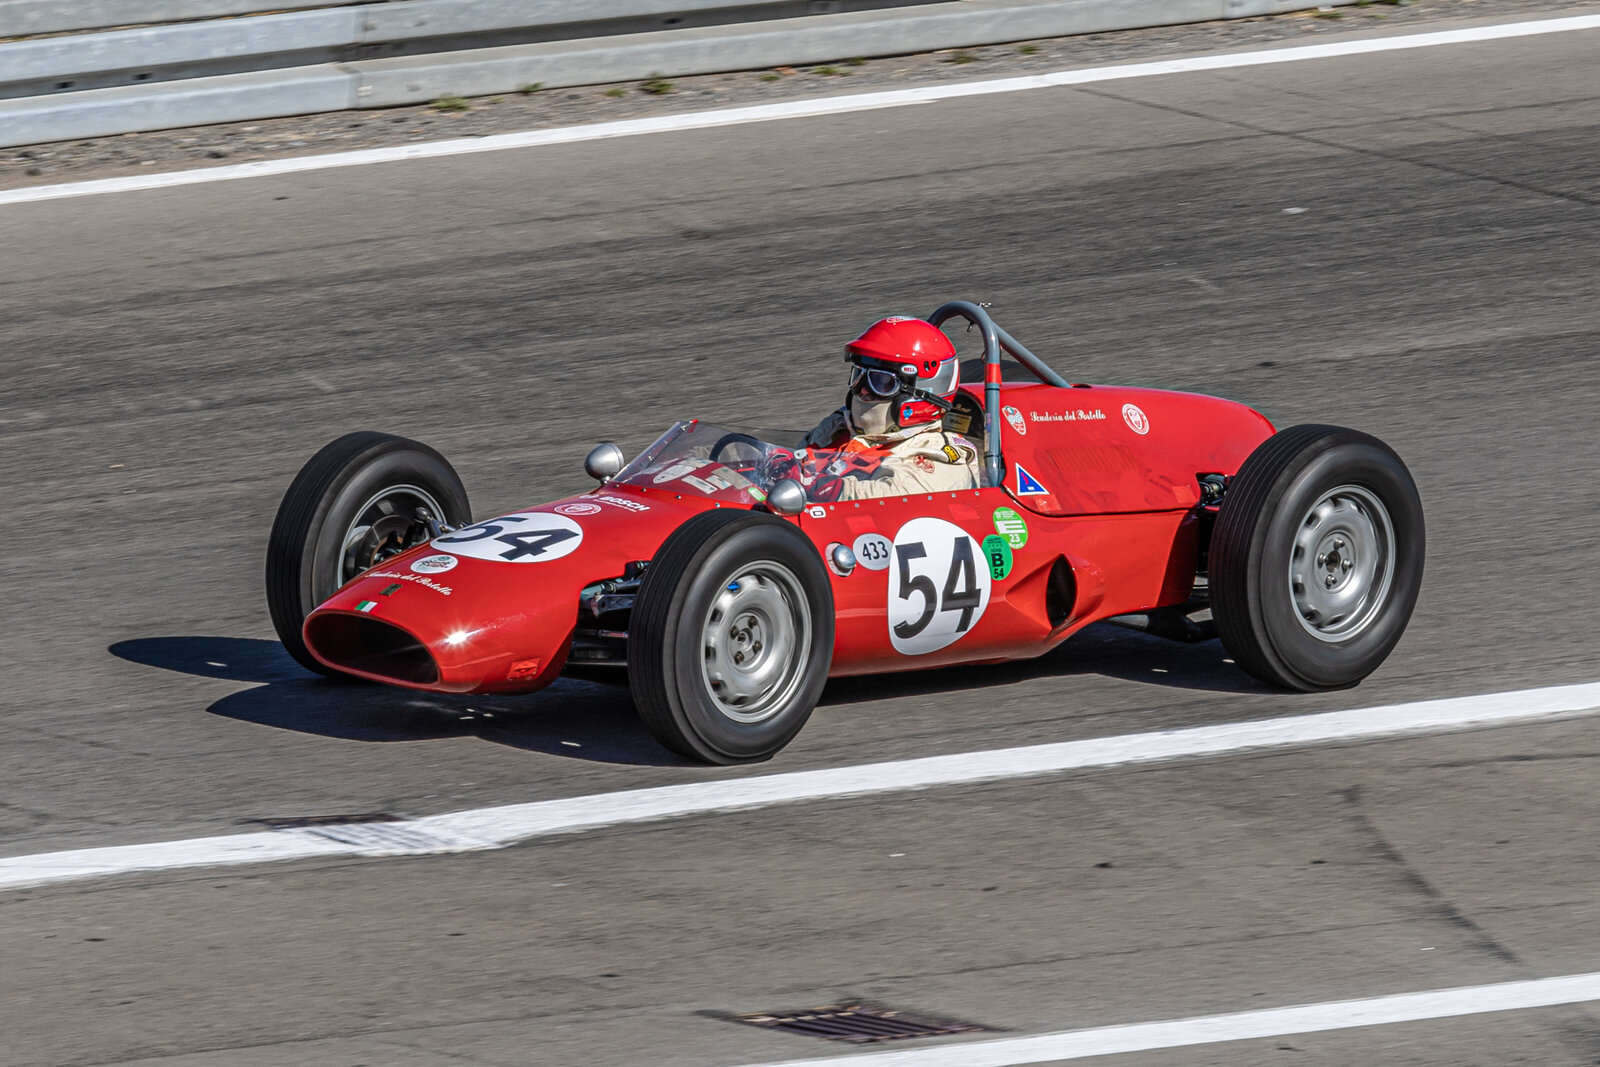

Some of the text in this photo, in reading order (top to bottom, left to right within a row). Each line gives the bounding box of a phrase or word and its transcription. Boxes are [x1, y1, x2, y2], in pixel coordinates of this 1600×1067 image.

[1030, 409, 1106, 422] Scuderia del Portello
[599, 496, 650, 511] BOSCH
[437, 517, 580, 561] 54
[1009, 534, 1021, 543] 23
[863, 541, 889, 561] 433
[991, 552, 1005, 567] B
[993, 567, 1005, 579] 54
[893, 536, 982, 640] 54
